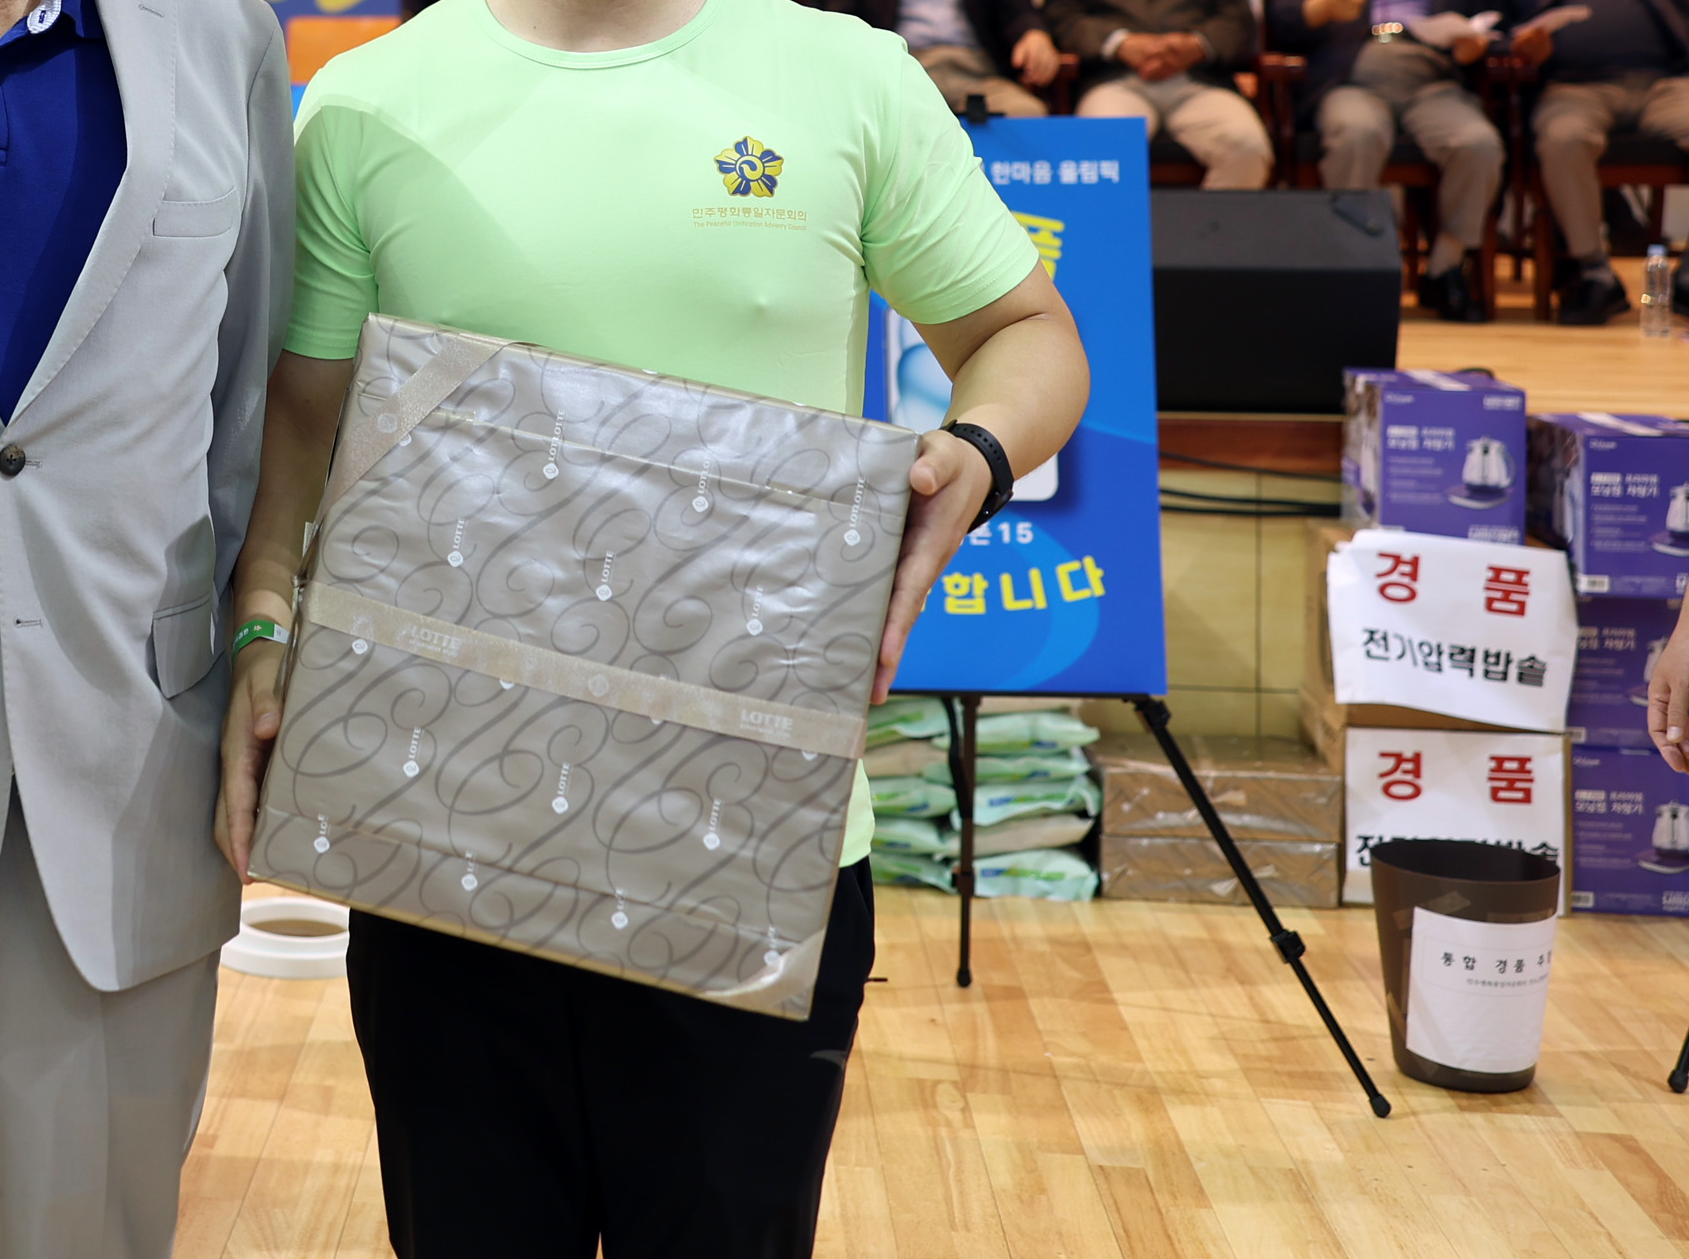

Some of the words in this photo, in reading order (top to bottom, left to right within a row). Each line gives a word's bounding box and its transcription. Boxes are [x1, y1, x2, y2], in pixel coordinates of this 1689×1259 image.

[990, 160, 1052, 185] 한마음
[1059, 160, 1120, 184] 올림픽
[692, 207, 807, 222] 민주평화통일자문회의
[453, 518, 466, 549] LOTTE
[998, 521, 1034, 544] 15
[601, 551, 614, 583] LOTTE
[921, 555, 1106, 615] 합니다
[741, 709, 793, 731] LOTTE
[409, 726, 421, 759] LOTTE
[558, 762, 571, 795] LOTTE
[710, 799, 722, 832] LOTTE
